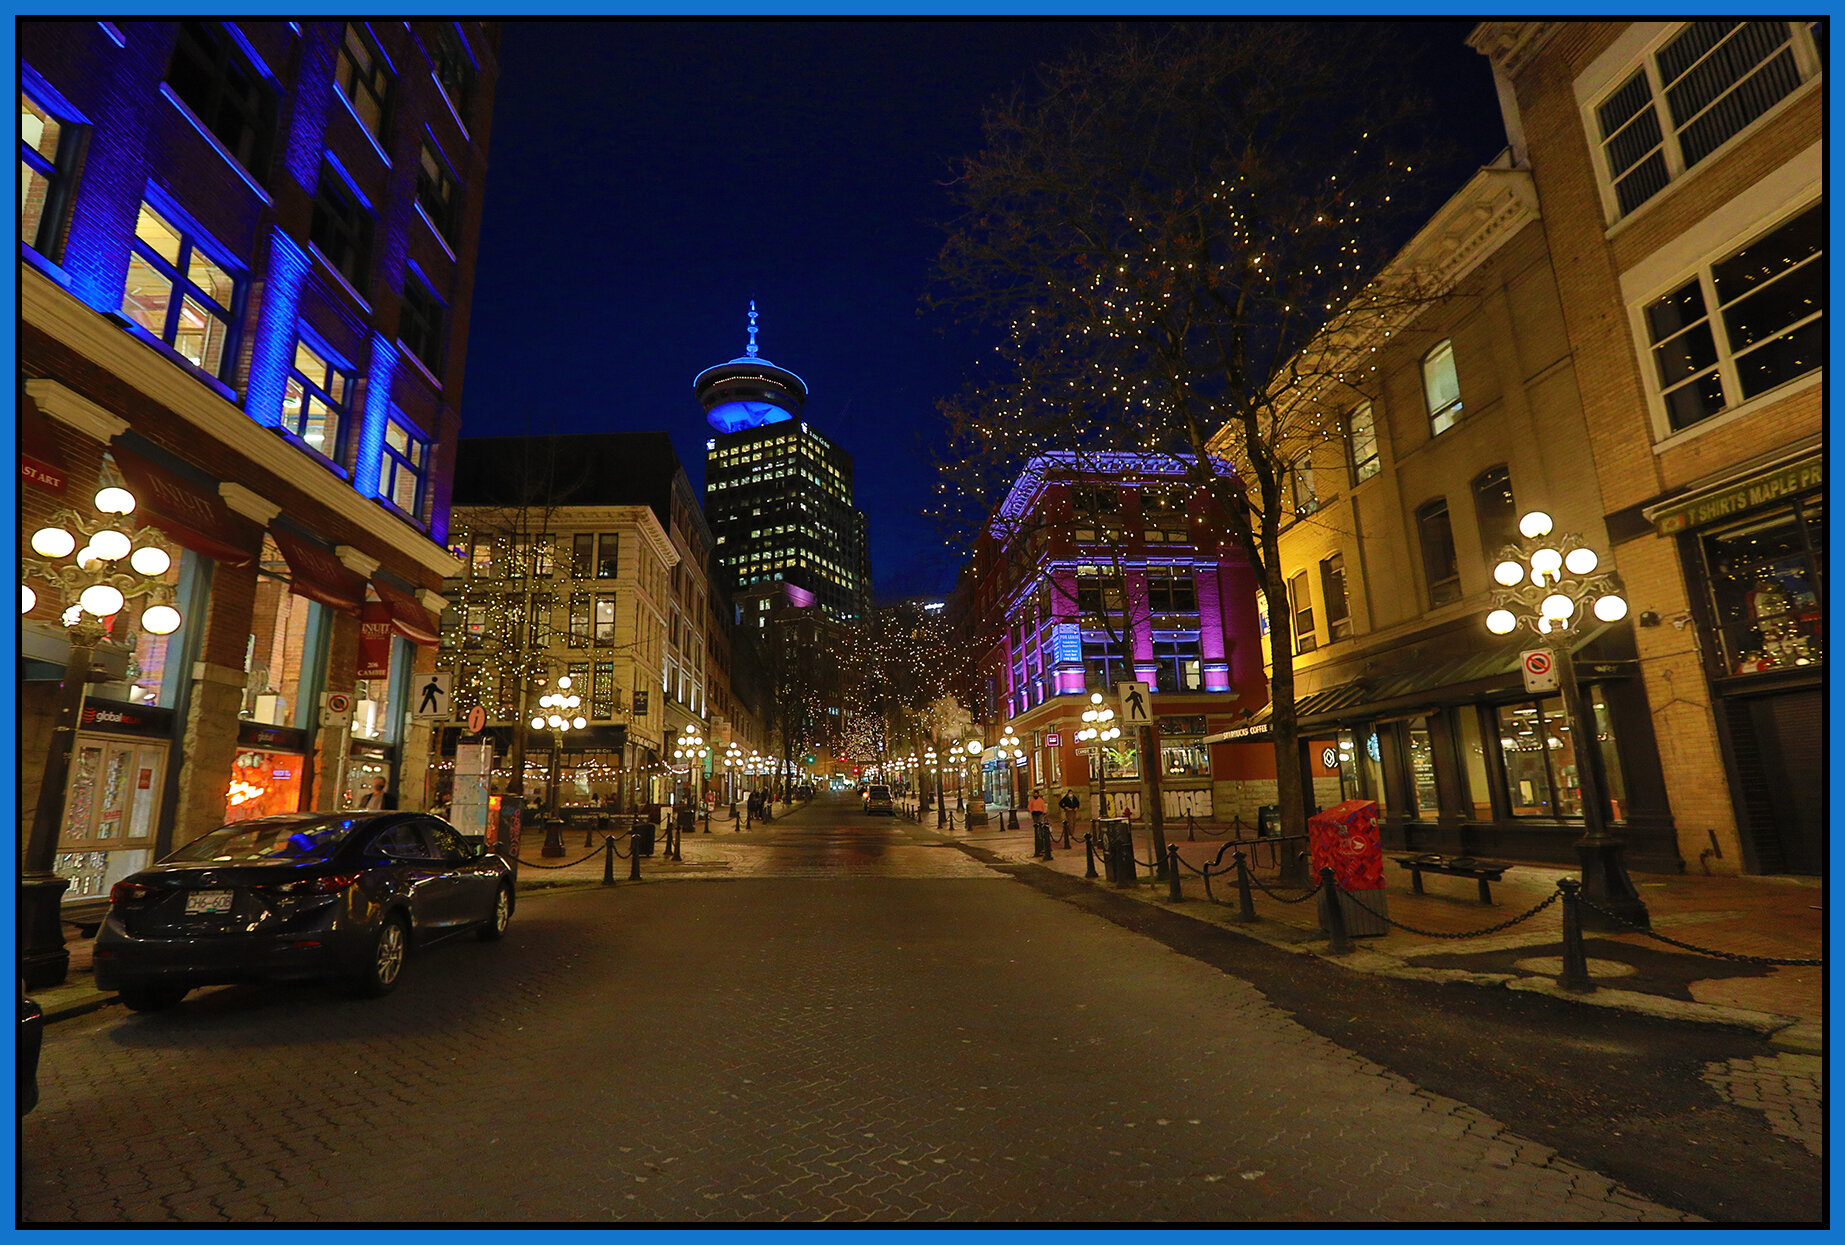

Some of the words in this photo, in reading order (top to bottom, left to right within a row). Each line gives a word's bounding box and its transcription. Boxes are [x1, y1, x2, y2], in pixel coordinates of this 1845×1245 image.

[37, 473, 61, 487] ART
[146, 472, 214, 520] INUIT
[1699, 491, 1748, 522] SHIRTS
[1750, 475, 1797, 505] MAPLE
[361, 623, 391, 632] INUIT
[1249, 724, 1268, 735] COFFEE
